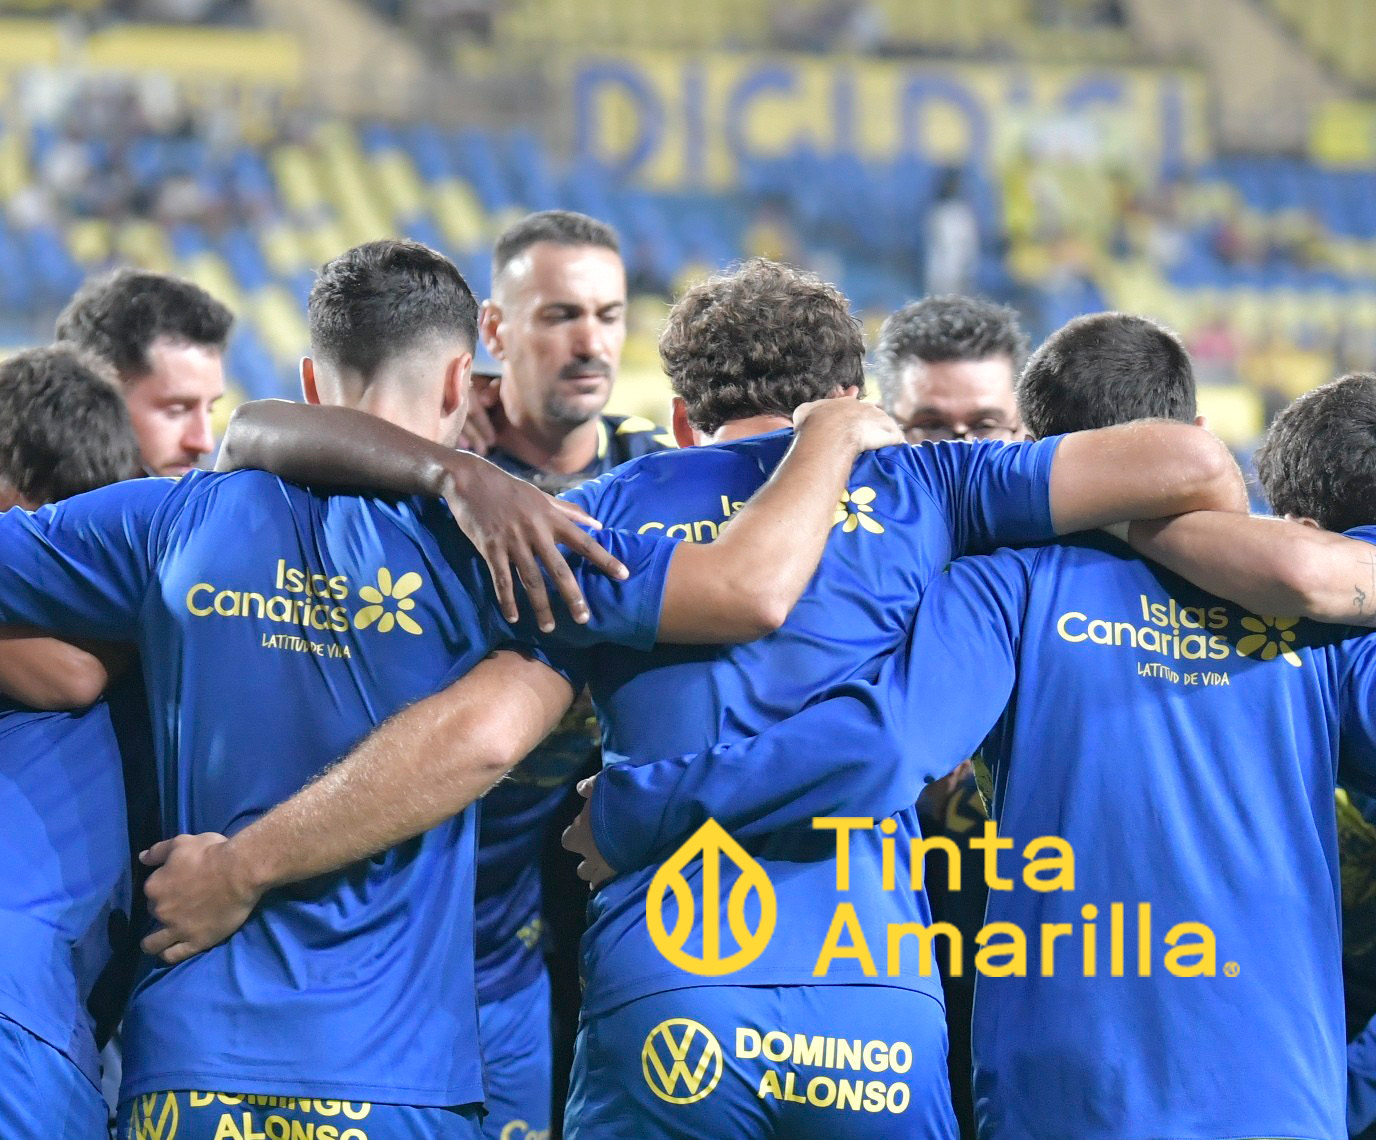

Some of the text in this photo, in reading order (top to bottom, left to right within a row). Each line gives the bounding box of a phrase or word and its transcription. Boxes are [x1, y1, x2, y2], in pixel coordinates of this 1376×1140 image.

[275, 559, 348, 600] Islas
[186, 583, 349, 632] Canarias
[1140, 594, 1229, 629] Islas
[326, 643, 352, 659] VIA
[1057, 612, 1230, 660] Canarias
[1137, 662, 1230, 686] LATITUD DE VIDA
[736, 1028, 913, 1074] DOMINGO
[757, 1070, 910, 1114] ALONSO
